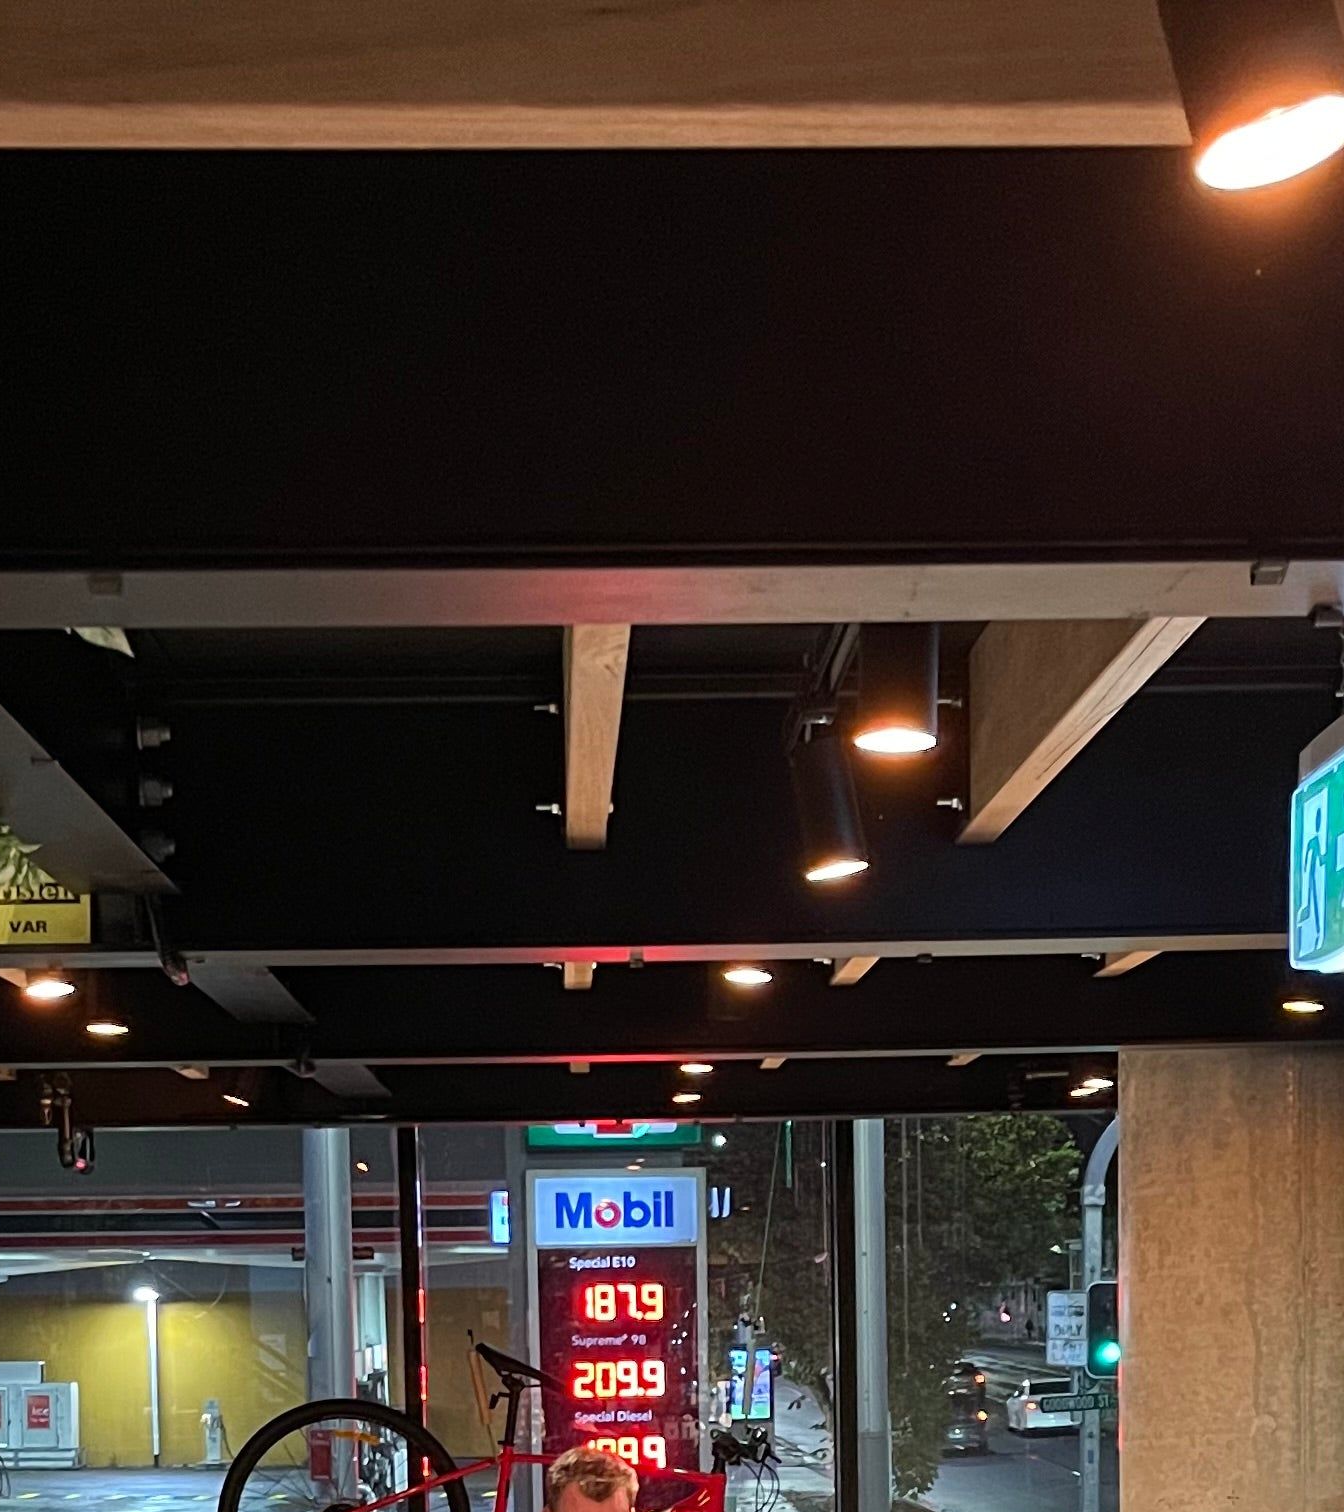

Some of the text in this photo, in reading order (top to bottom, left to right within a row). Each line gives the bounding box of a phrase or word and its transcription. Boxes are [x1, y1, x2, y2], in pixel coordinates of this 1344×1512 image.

[9, 920, 48, 934] VAR
[555, 1190, 674, 1229] Mobil
[569, 1255, 636, 1272] Special E10
[573, 1359, 666, 1399] 209.9
[616, 1409, 653, 1422] Diesel
